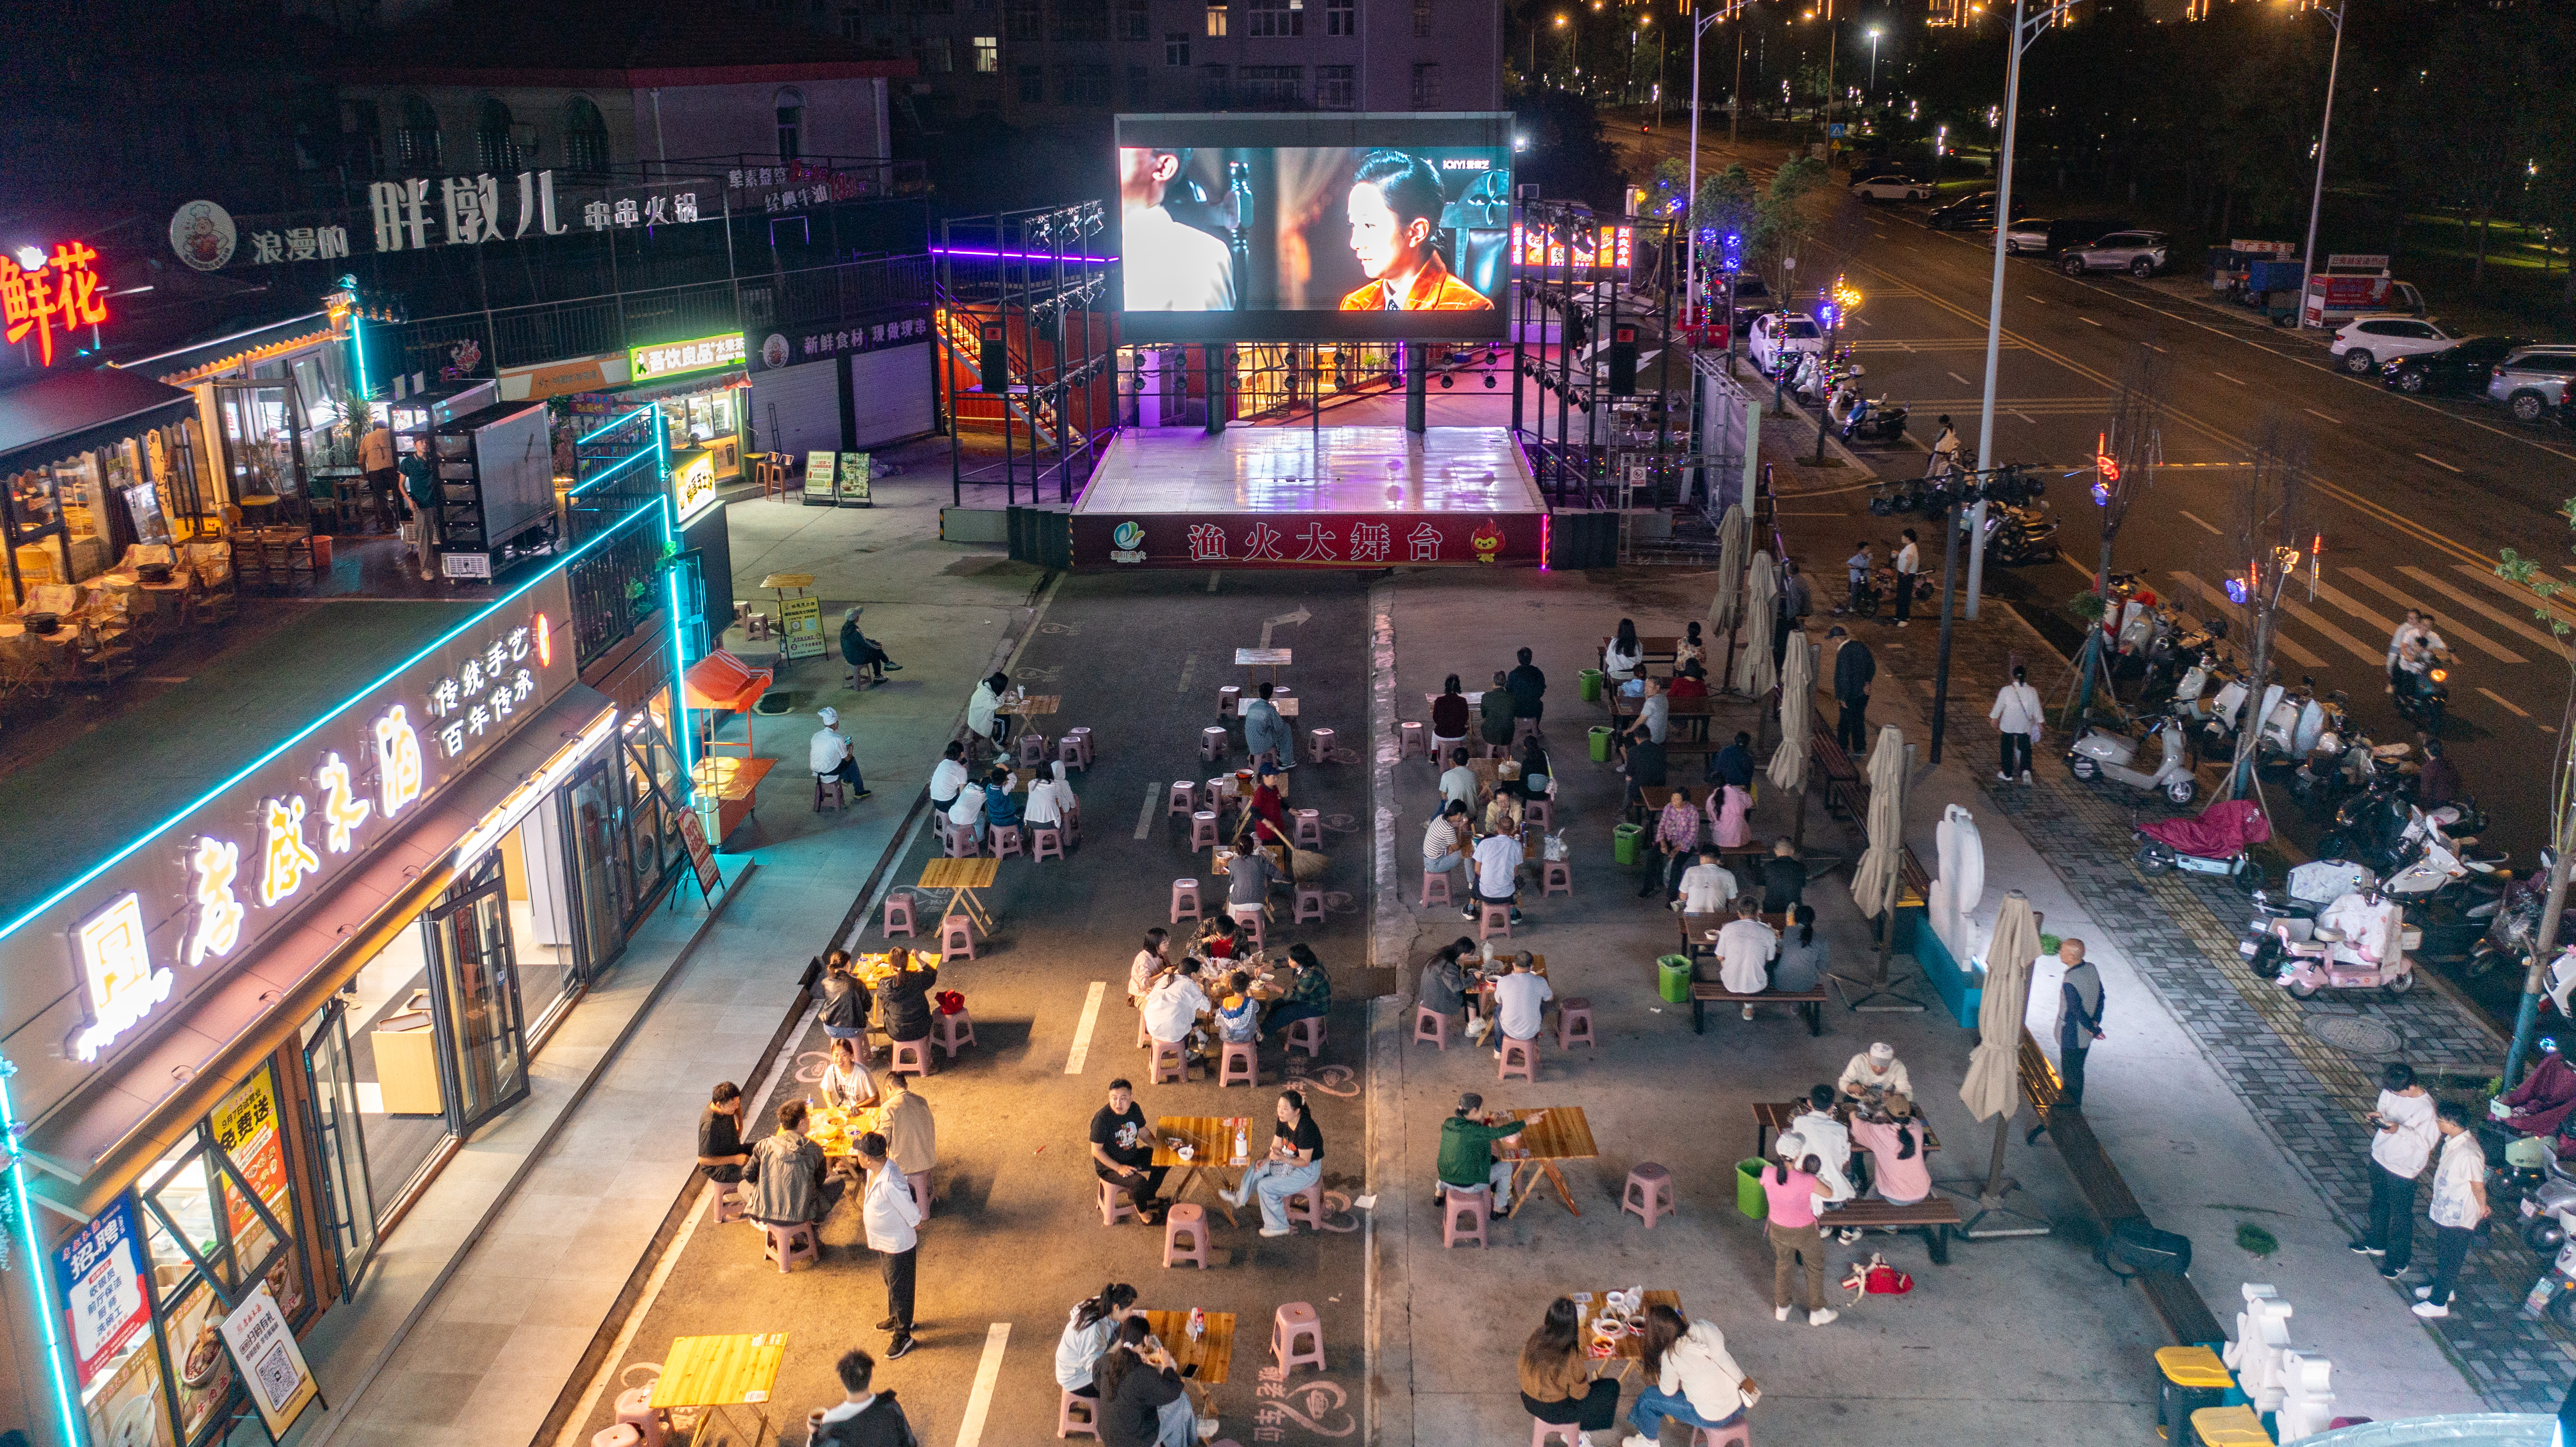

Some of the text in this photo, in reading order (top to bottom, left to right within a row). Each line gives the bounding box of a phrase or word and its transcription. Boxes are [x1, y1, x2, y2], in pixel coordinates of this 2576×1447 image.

[252, 225, 350, 265] 浪漫的
[369, 170, 568, 252] 胖墩儿
[584, 193, 698, 231] 串串火锅
[0, 241, 106, 367] 鲜花
[715, 338, 745, 354] 水果茶
[804, 318, 926, 355] 新鲜食材 现做现串
[1187, 522, 1443, 562] 渔火大舞台
[436, 627, 528, 718] 传统手艺
[442, 669, 534, 757] 百年传承
[220, 1094, 269, 1153] 免费送
[221, 1087, 262, 1129] 9月7日试营业
[70, 1219, 119, 1280] 招聘
[87, 1275, 122, 1316] 前厅保洁
[90, 1267, 115, 1297] 收银员
[97, 1304, 123, 1337] 洗碗工
[98, 1295, 117, 1320] 厨师
[248, 1310, 275, 1345] 扫码有礼
[197, 1374, 228, 1415] 牛肉面
